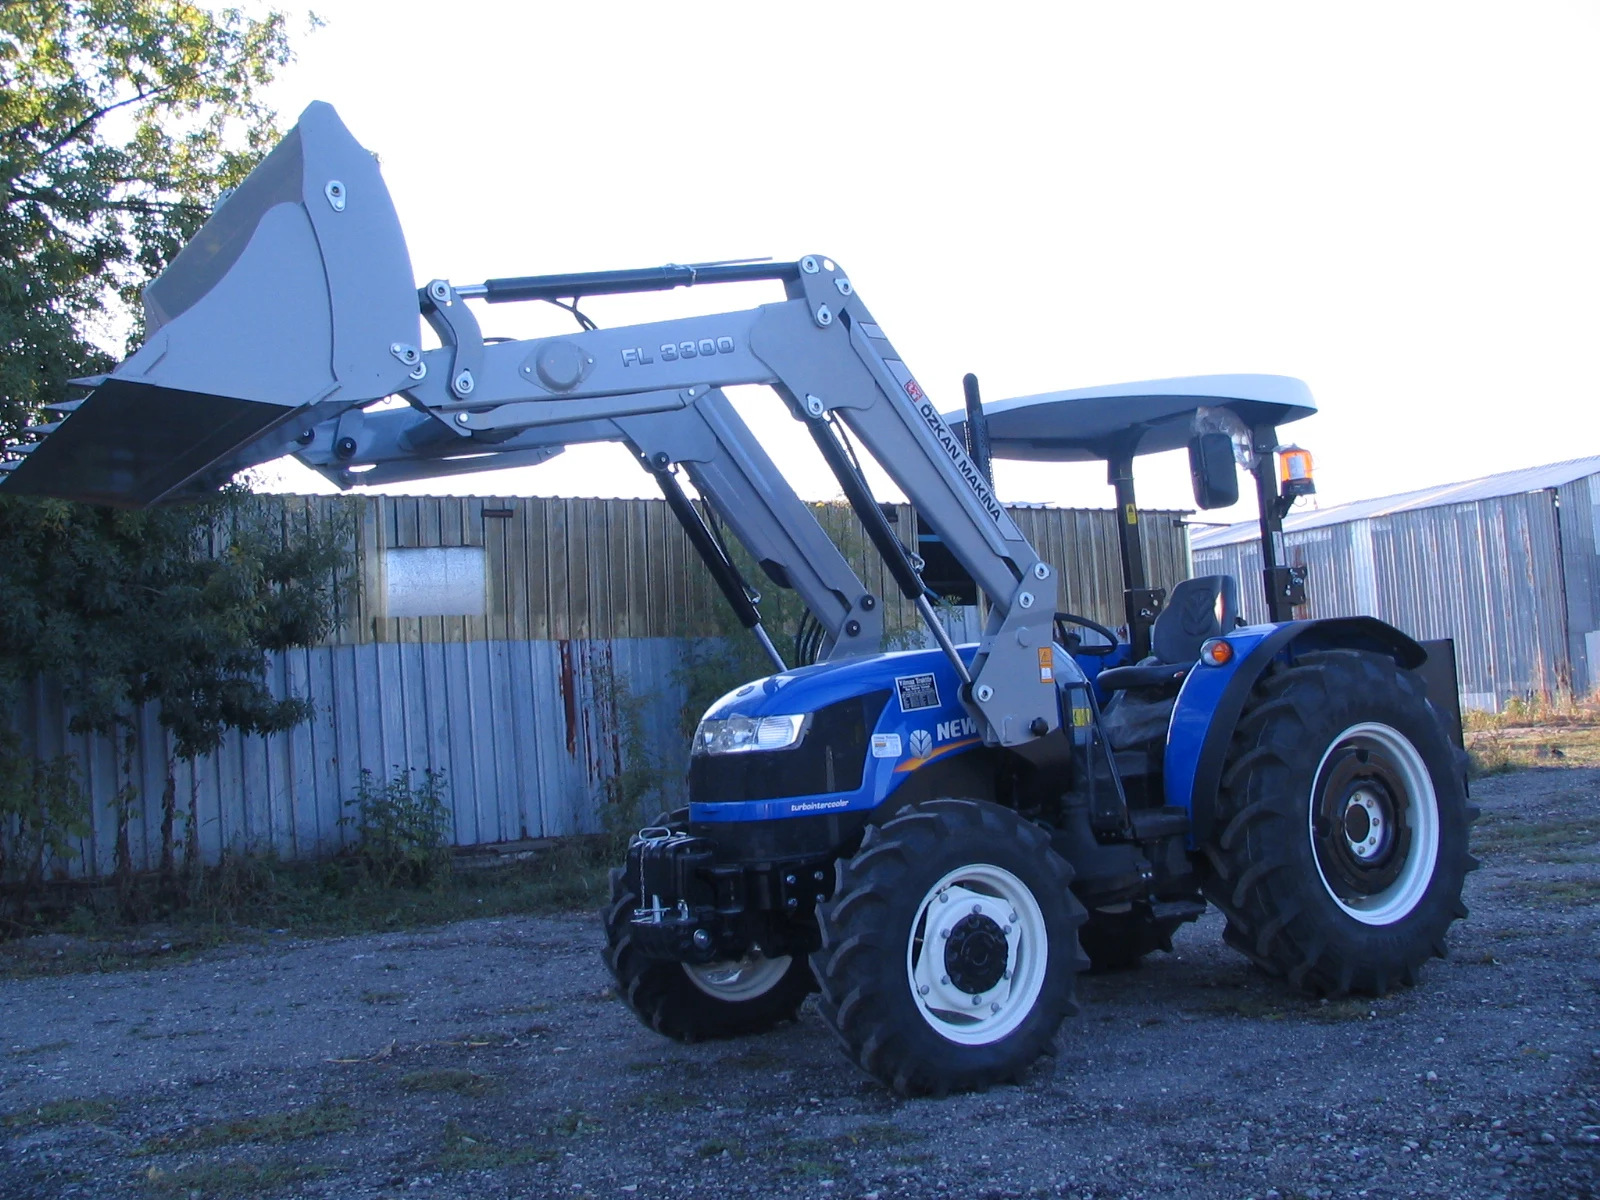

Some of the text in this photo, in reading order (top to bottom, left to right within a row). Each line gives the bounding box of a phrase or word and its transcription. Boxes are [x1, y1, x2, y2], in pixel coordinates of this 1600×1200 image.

[621, 336, 735, 368] FL 3300
[920, 403, 960, 461] ÖZKAN
[936, 717, 977, 741] NEW
[791, 799, 849, 812] turbointercooler
